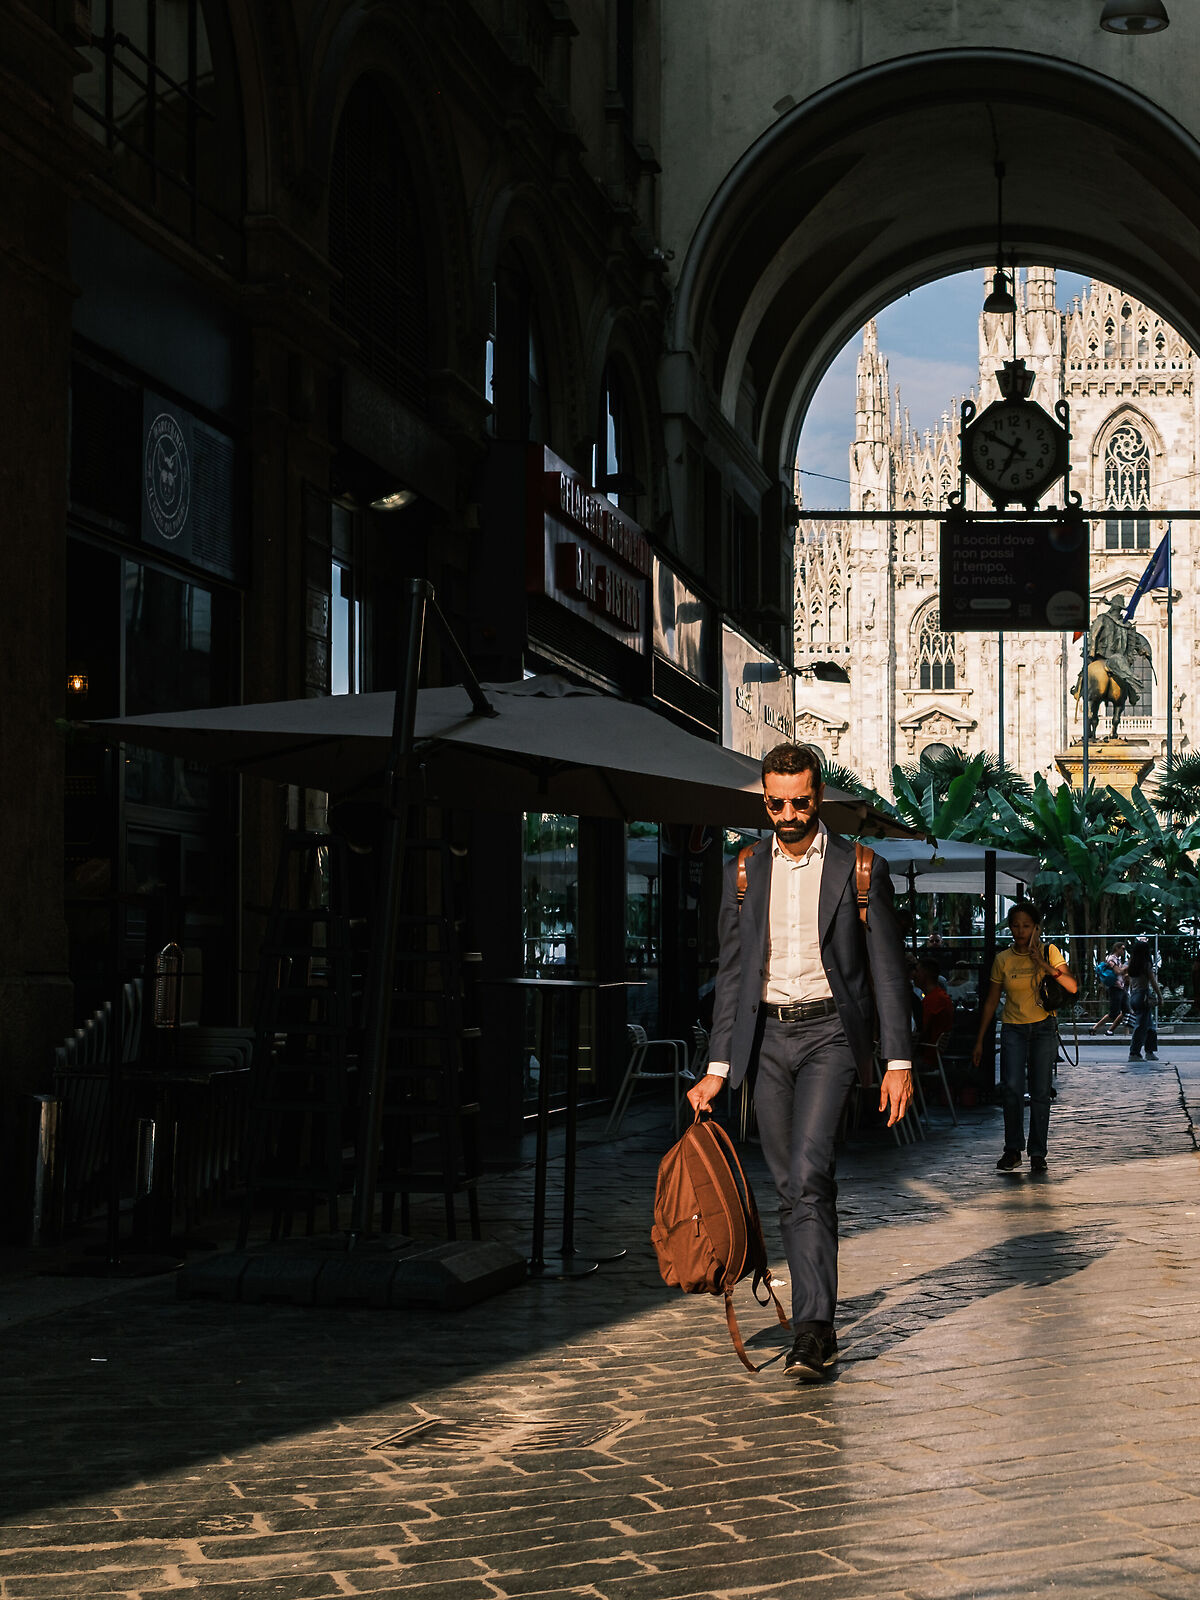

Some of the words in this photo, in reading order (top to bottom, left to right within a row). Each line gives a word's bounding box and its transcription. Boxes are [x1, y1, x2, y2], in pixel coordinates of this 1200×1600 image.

[993, 419, 1003, 430] 11
[1007, 415, 1020, 427] 12
[1025, 419, 1031, 430] 1
[1036, 429, 1045, 441] 2
[979, 445, 989, 456] 9
[1041, 443, 1049, 455] 3
[986, 459, 995, 470] 8
[1036, 458, 1044, 469] 4
[1010, 473, 1020, 485] 6
[1025, 468, 1034, 480] 5
[953, 534, 960, 545] Il
[963, 533, 1000, 545] social
[1003, 533, 1035, 545] dove
[953, 550, 978, 559] non
[980, 547, 1015, 561] passi
[953, 573, 969, 585] Lo
[971, 573, 1017, 585] investi.
